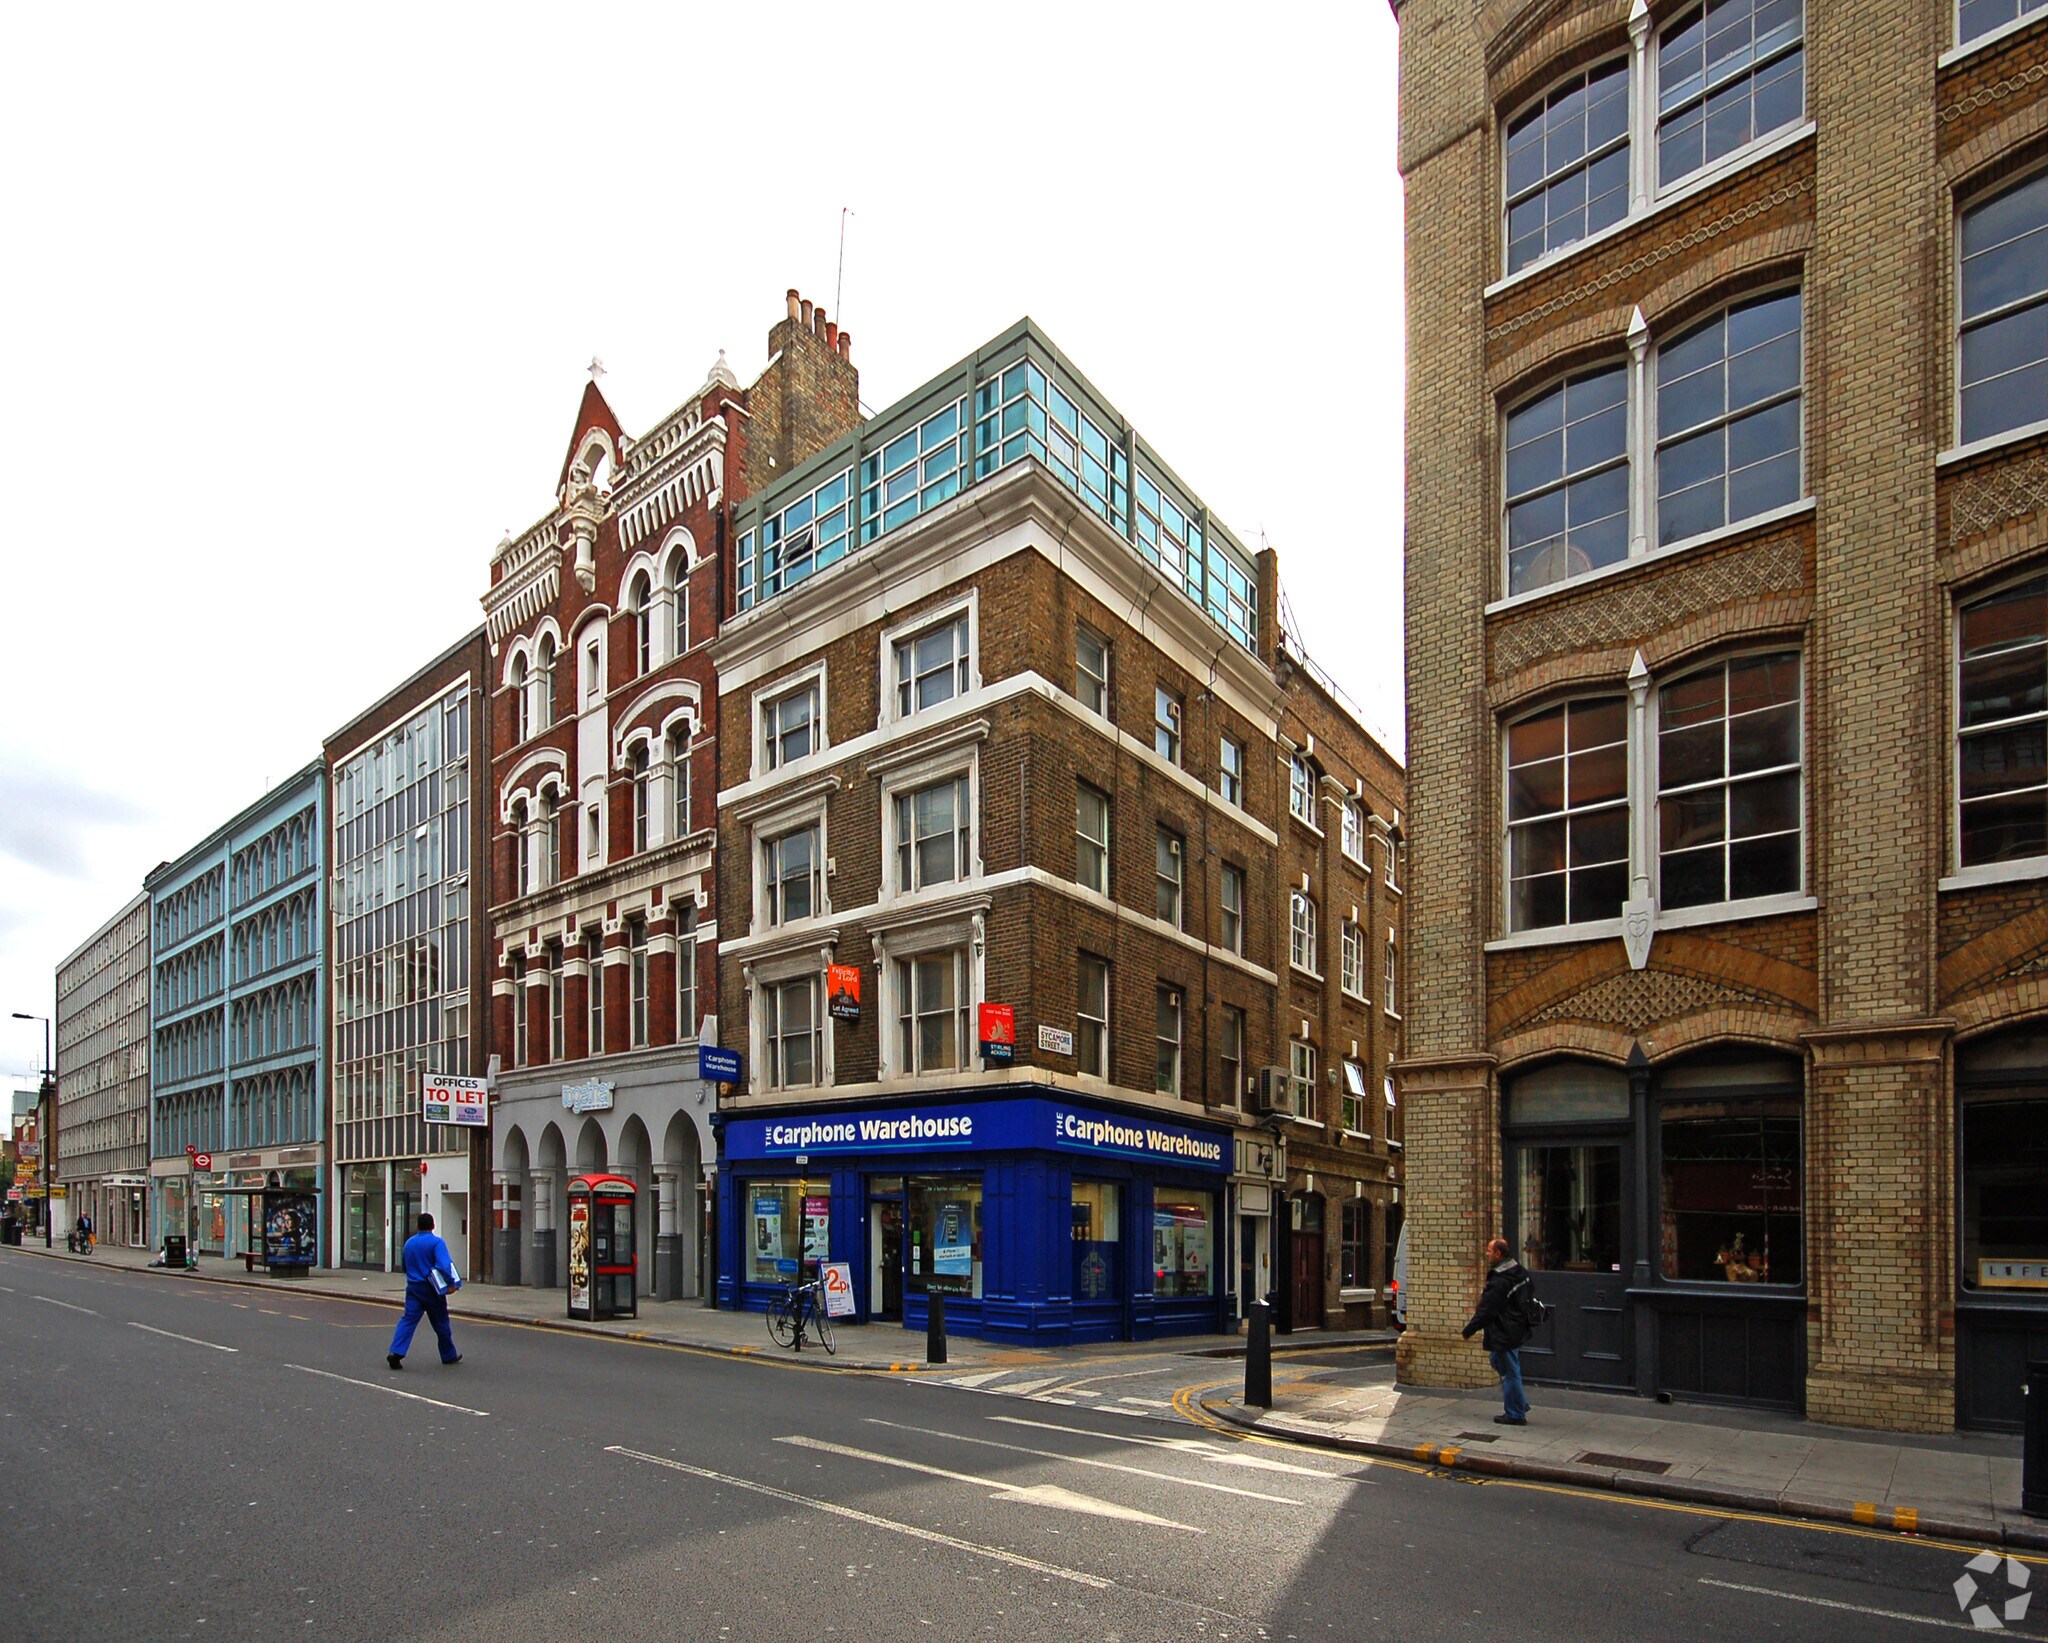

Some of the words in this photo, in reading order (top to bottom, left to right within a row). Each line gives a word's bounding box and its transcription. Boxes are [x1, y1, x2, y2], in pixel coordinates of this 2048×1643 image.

[832, 967, 855, 977] Felicity
[843, 974, 858, 983] Lord
[832, 1004, 841, 1012] Let
[842, 1005, 859, 1014] Agreed
[1040, 1031, 1070, 1045] SYCAMORE
[1040, 1040, 1060, 1050] STREET
[708, 1055, 737, 1065] Carphone
[705, 1063, 737, 1073] Warehouse
[433, 1077, 478, 1088] OFFICES
[426, 1088, 450, 1102] TO
[456, 1090, 485, 1104] LET
[773, 1122, 856, 1147] Carphone
[859, 1115, 973, 1140] Warehouse
[1056, 1112, 1064, 1137] THE
[1065, 1115, 1144, 1148] Carphone
[1146, 1129, 1221, 1160] Warehouse
[826, 1269, 847, 1294] 2p
